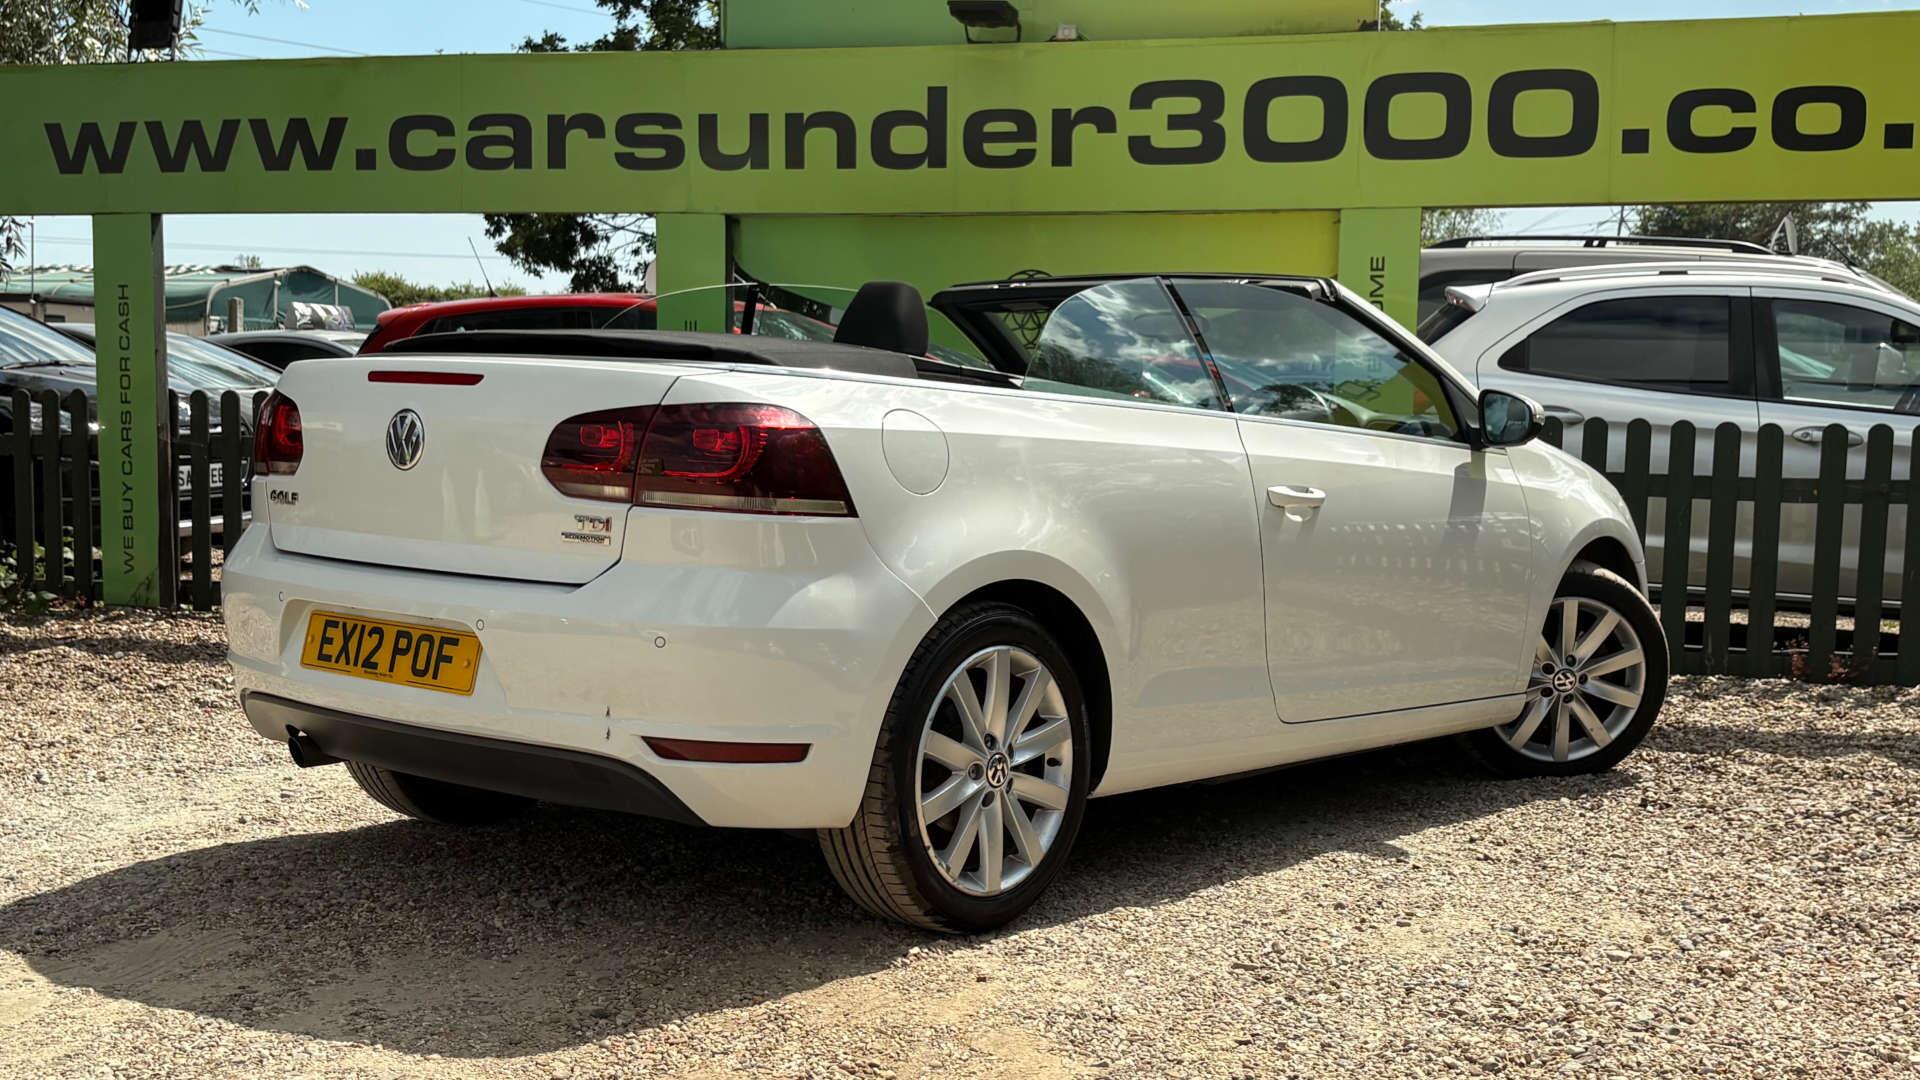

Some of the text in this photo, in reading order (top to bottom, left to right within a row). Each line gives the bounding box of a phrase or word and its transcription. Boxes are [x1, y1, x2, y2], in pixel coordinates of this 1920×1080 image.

[117, 284, 135, 575] WE BUY CARS FOR CASH
[270, 489, 299, 505] GOLF
[317, 619, 460, 680] EX12 POF
